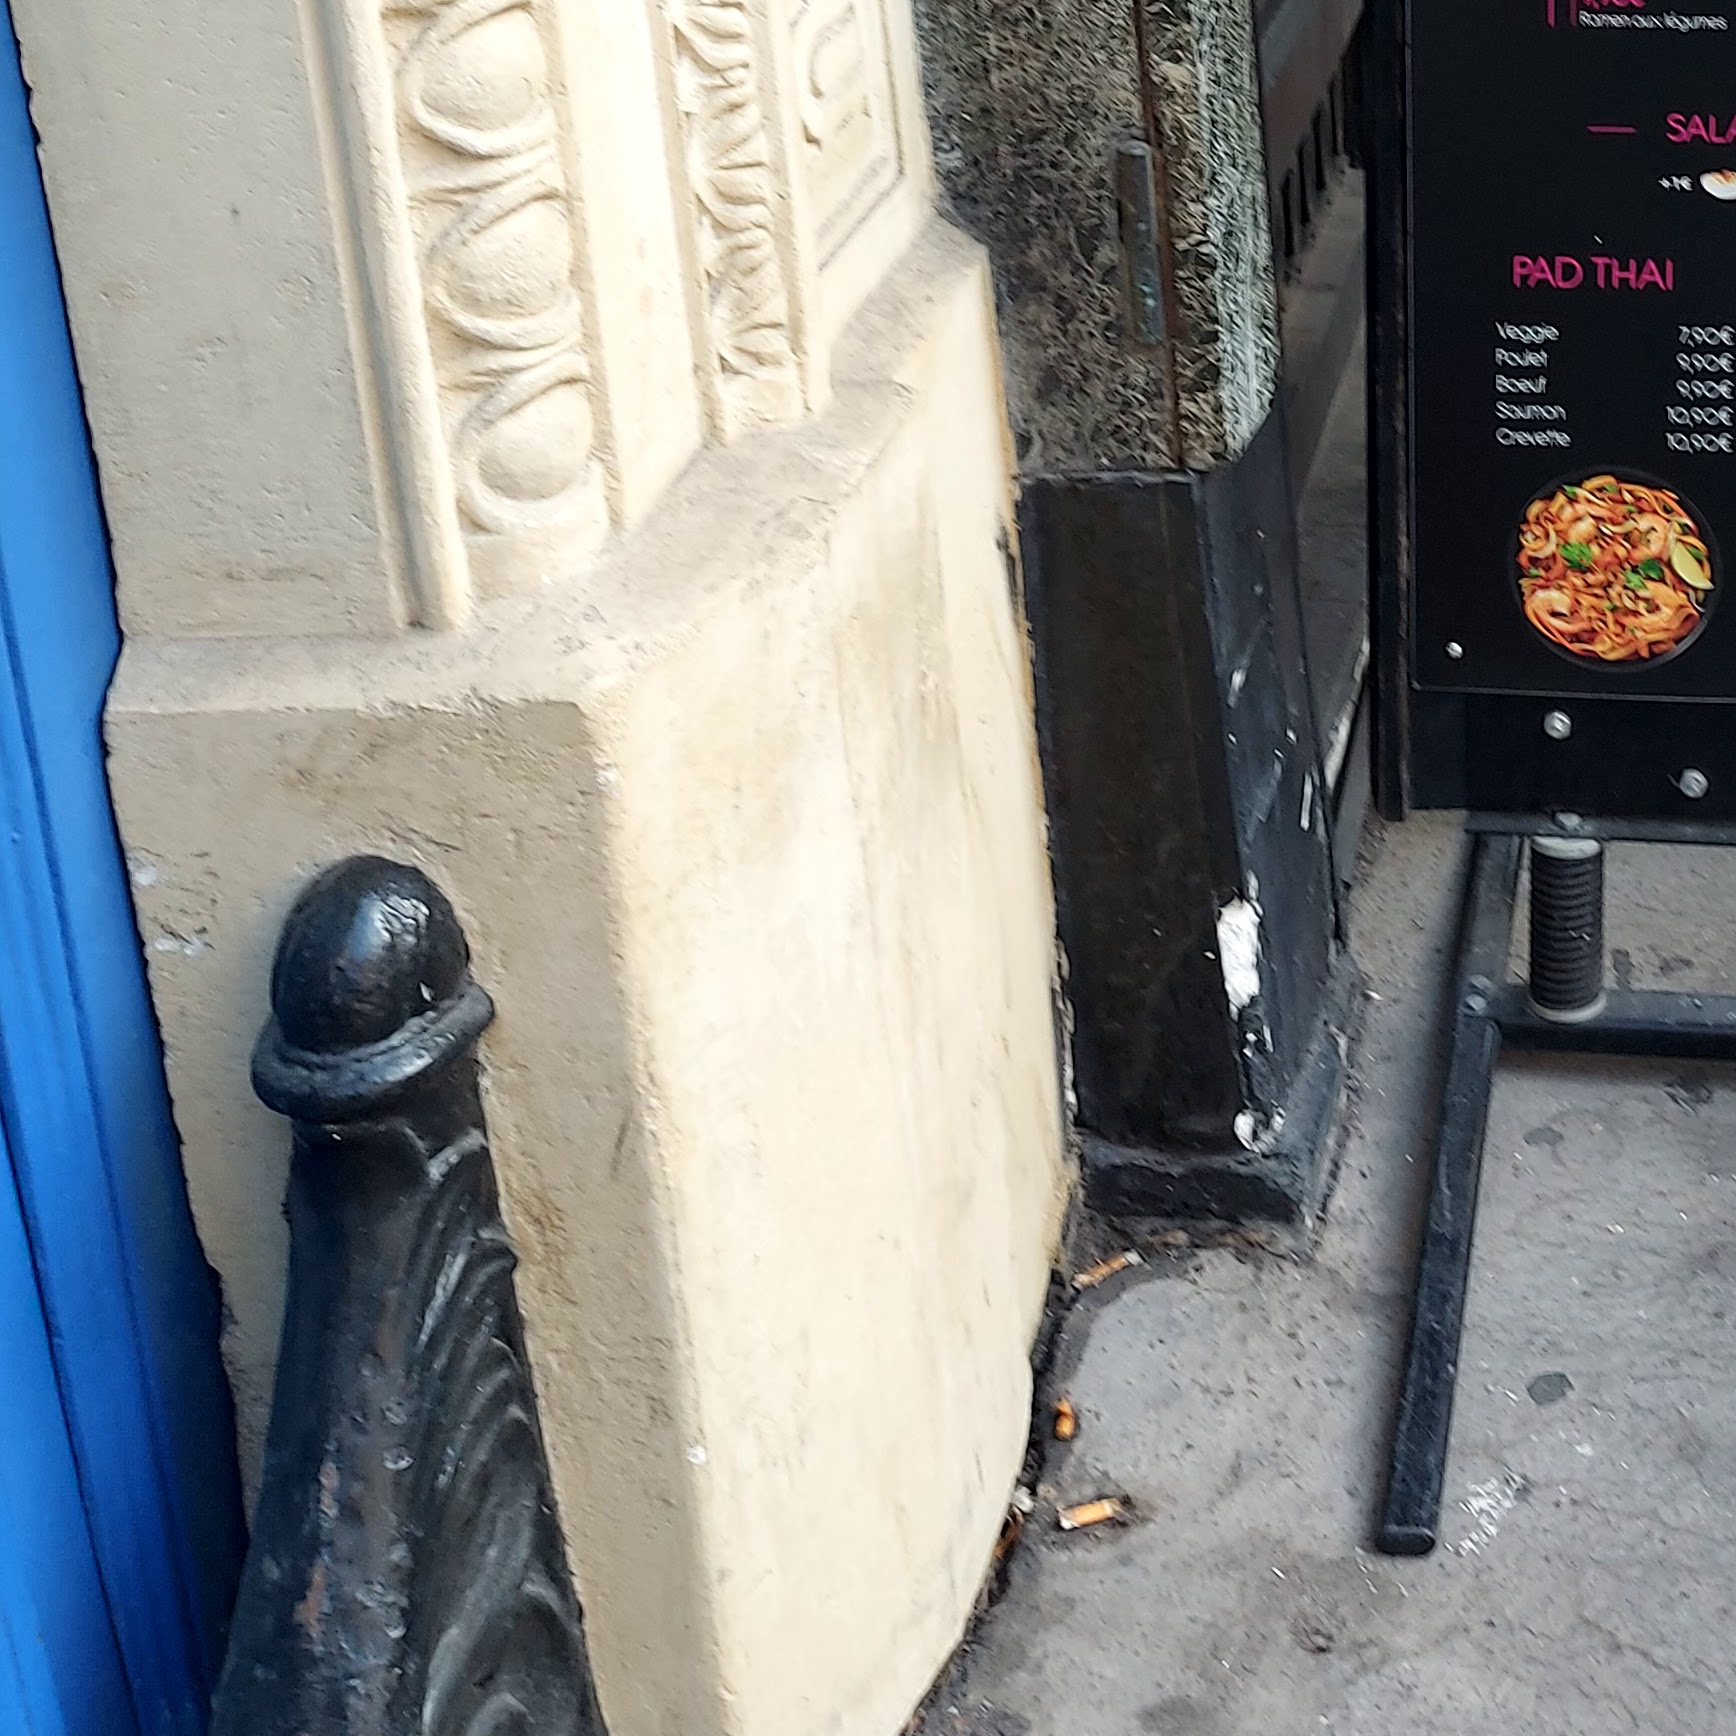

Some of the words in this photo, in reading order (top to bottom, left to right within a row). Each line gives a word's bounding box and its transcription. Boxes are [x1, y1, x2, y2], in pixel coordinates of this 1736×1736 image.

[1512, 254, 1584, 290] PAD
[1590, 255, 1675, 291] THAI
[1495, 348, 1548, 367] Poulet
[1495, 400, 1567, 421] Saumon
